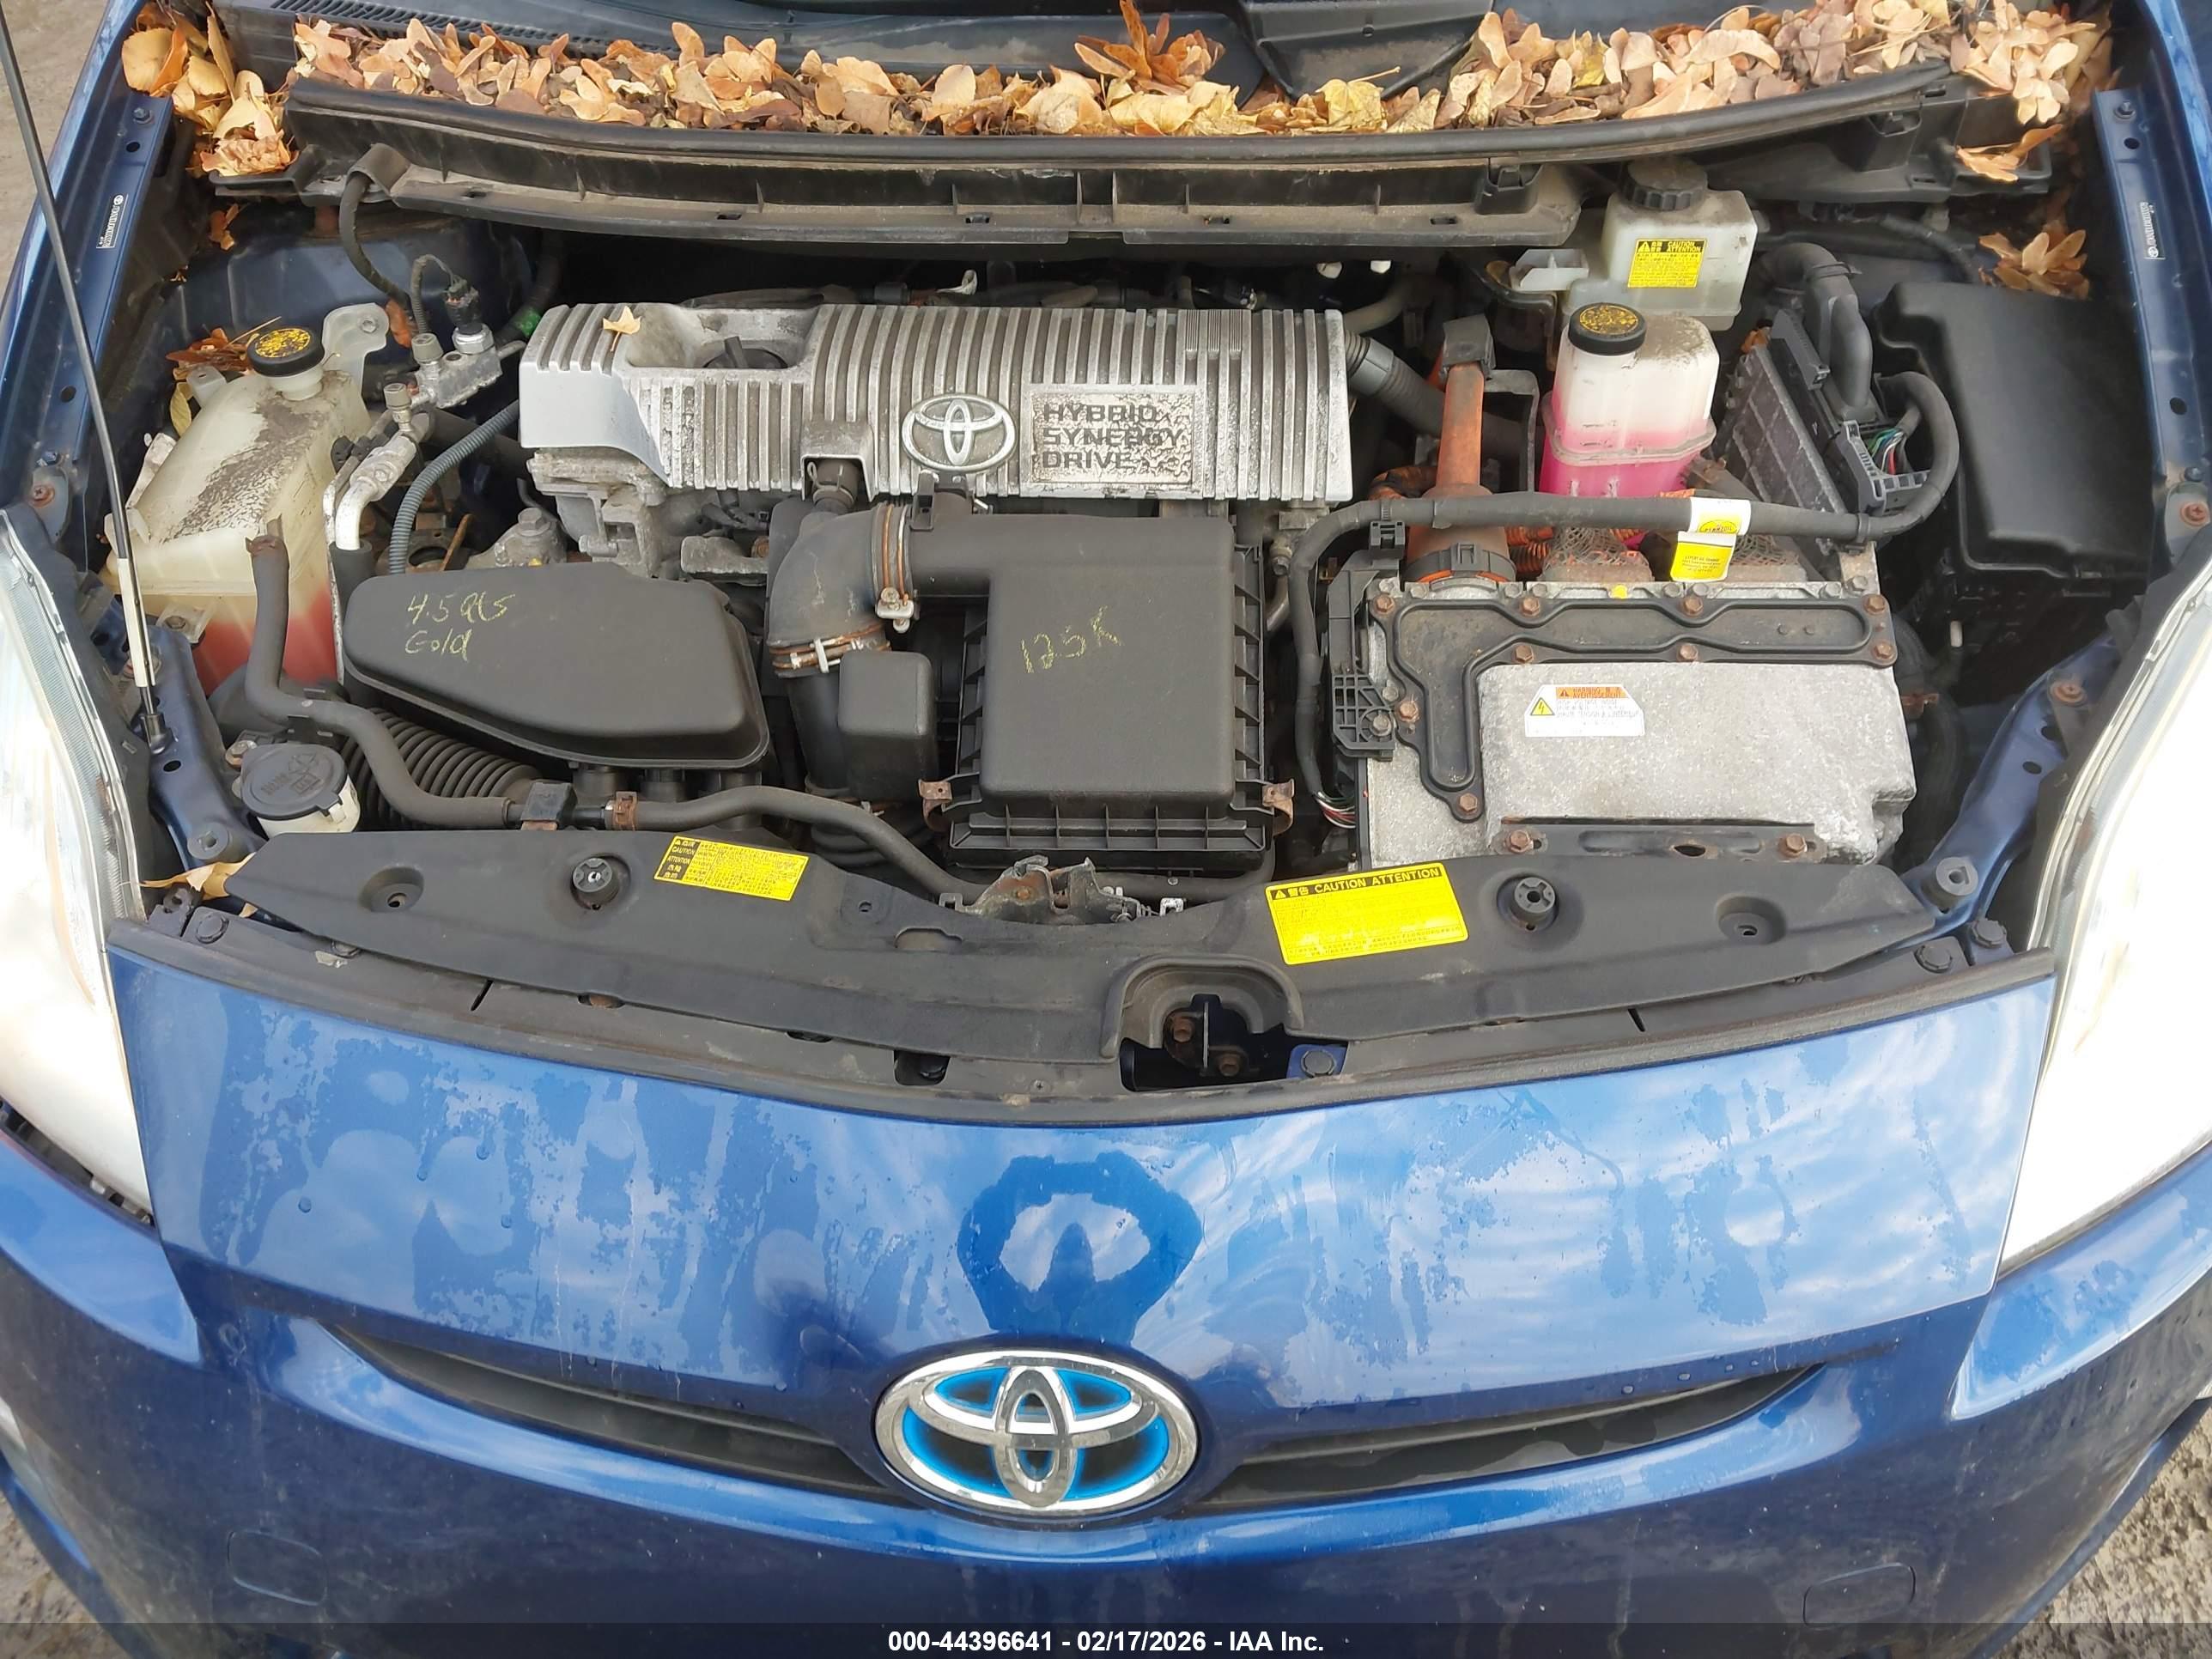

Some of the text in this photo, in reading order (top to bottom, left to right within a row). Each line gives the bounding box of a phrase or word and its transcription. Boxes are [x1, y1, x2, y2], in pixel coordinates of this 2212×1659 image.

[1043, 404, 1158, 422] HYBRID
[1042, 428, 1184, 447] SYNERGY
[1042, 450, 1136, 469] DRIVE
[407, 592, 455, 625] 4.5
[404, 627, 472, 661] Gold
[667, 855, 691, 865] ATTENTION
[672, 846, 696, 855] CAUTION
[1314, 878, 1367, 895] CAUTION
[1371, 867, 1440, 886] ATTENTION
